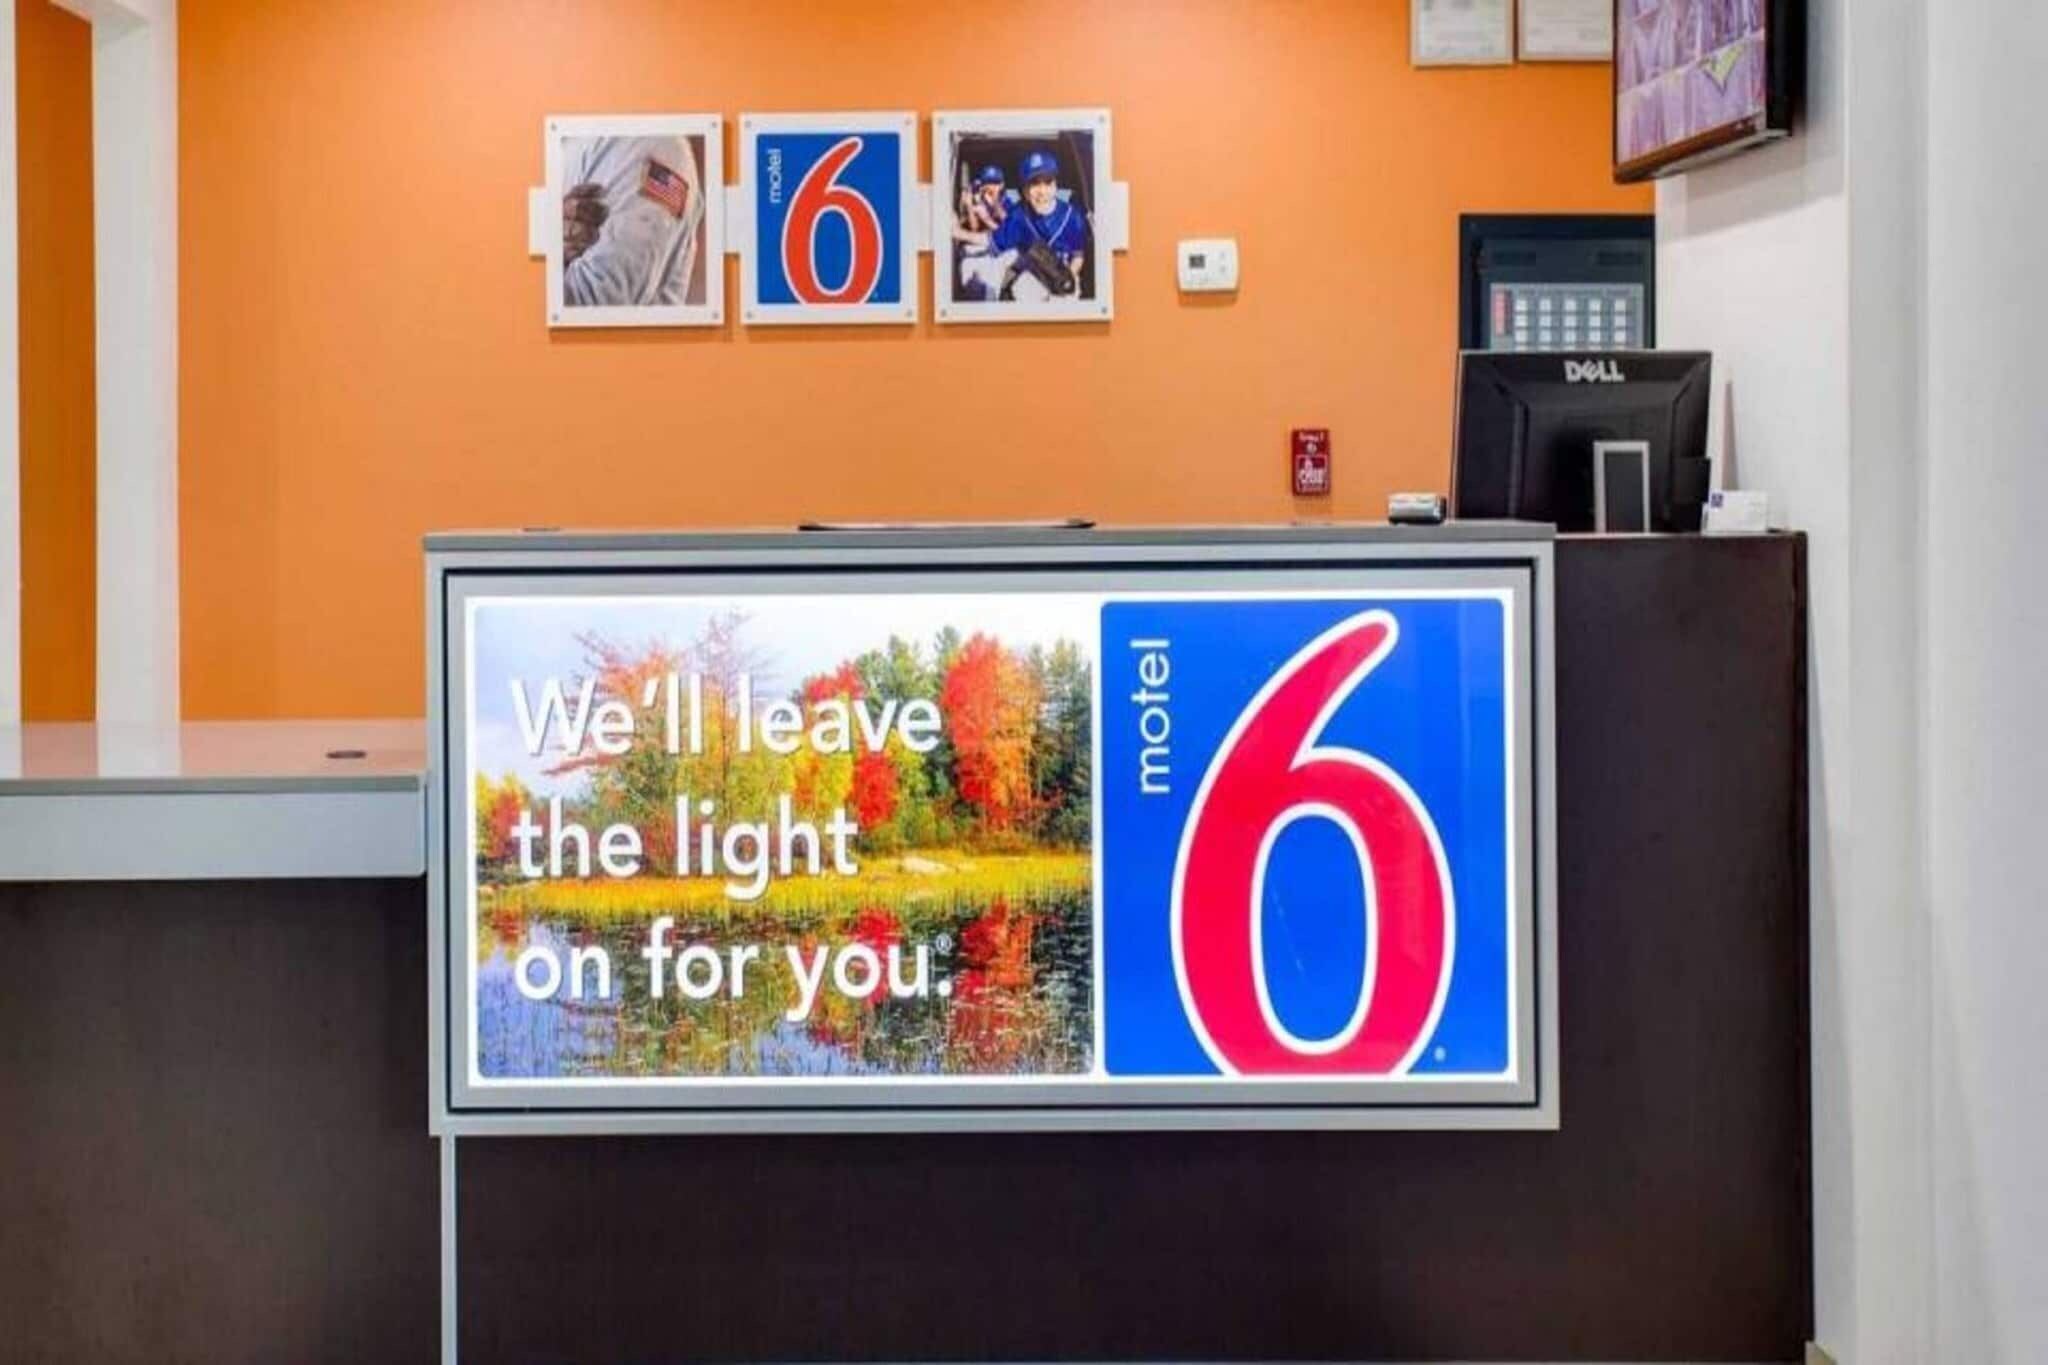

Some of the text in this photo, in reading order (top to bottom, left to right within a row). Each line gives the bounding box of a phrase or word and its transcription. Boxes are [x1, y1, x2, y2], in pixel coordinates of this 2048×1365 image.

[767, 148, 782, 203] motel
[781, 136, 884, 304] 6
[1564, 360, 1625, 382] DELL
[511, 671, 943, 756] We'll leave
[1130, 638, 1170, 793] motel
[511, 794, 859, 899] the light
[1170, 608, 1456, 1076] 6
[514, 942, 611, 1000] on
[643, 917, 759, 999] for
